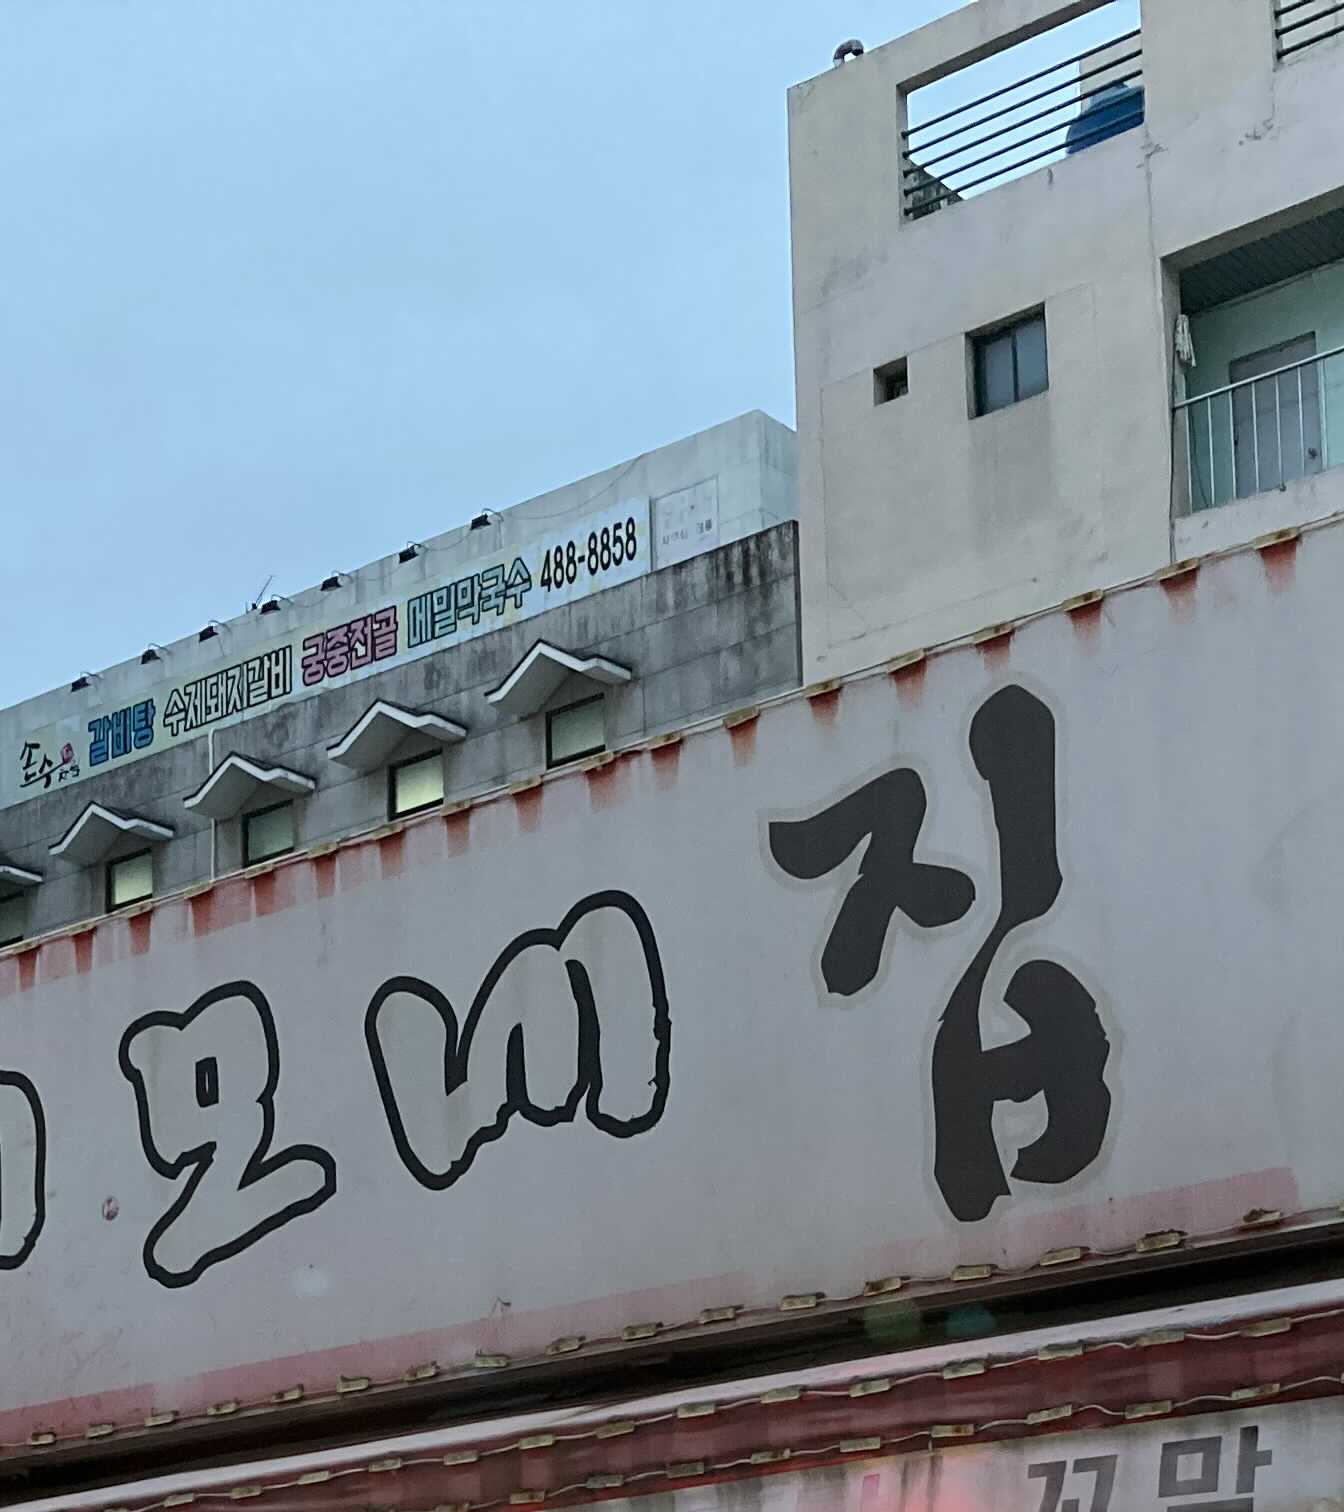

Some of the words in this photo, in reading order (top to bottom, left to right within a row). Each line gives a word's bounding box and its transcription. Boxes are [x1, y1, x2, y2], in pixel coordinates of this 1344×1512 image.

[87, 698, 156, 768] 갈비탕
[163, 644, 293, 736] 수제돼지갈비
[301, 605, 399, 687] 궁중전골
[407, 557, 533, 649] 메밀막국수
[540, 516, 638, 593] 488-8858
